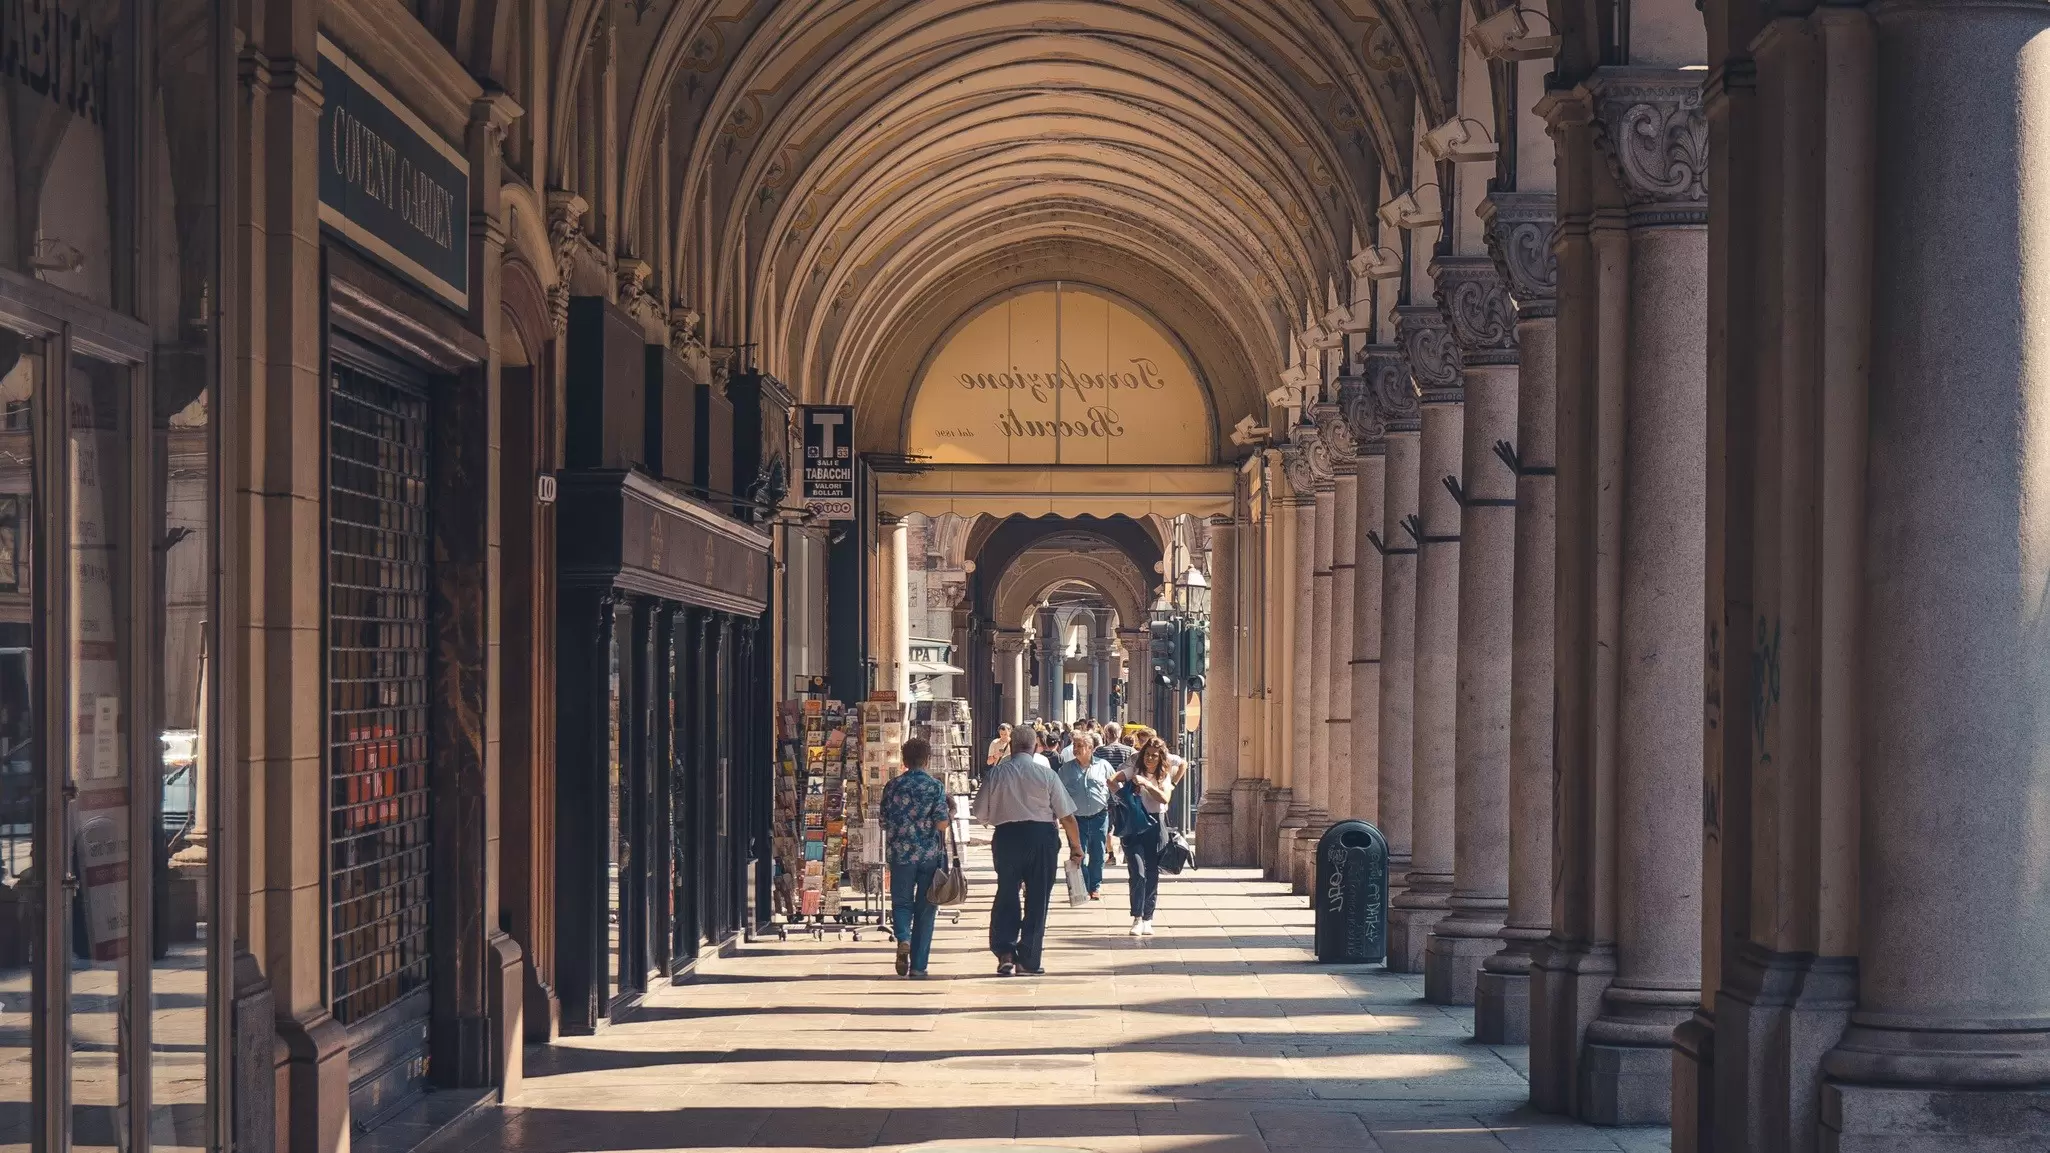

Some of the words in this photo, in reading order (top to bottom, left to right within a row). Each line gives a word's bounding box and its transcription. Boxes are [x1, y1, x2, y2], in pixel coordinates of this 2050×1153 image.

[334, 105, 397, 210] COVENT
[400, 157, 454, 252] GARDEN
[812, 413, 844, 458] T
[541, 478, 554, 498] 10
[805, 468, 851, 480] TABACCHI
